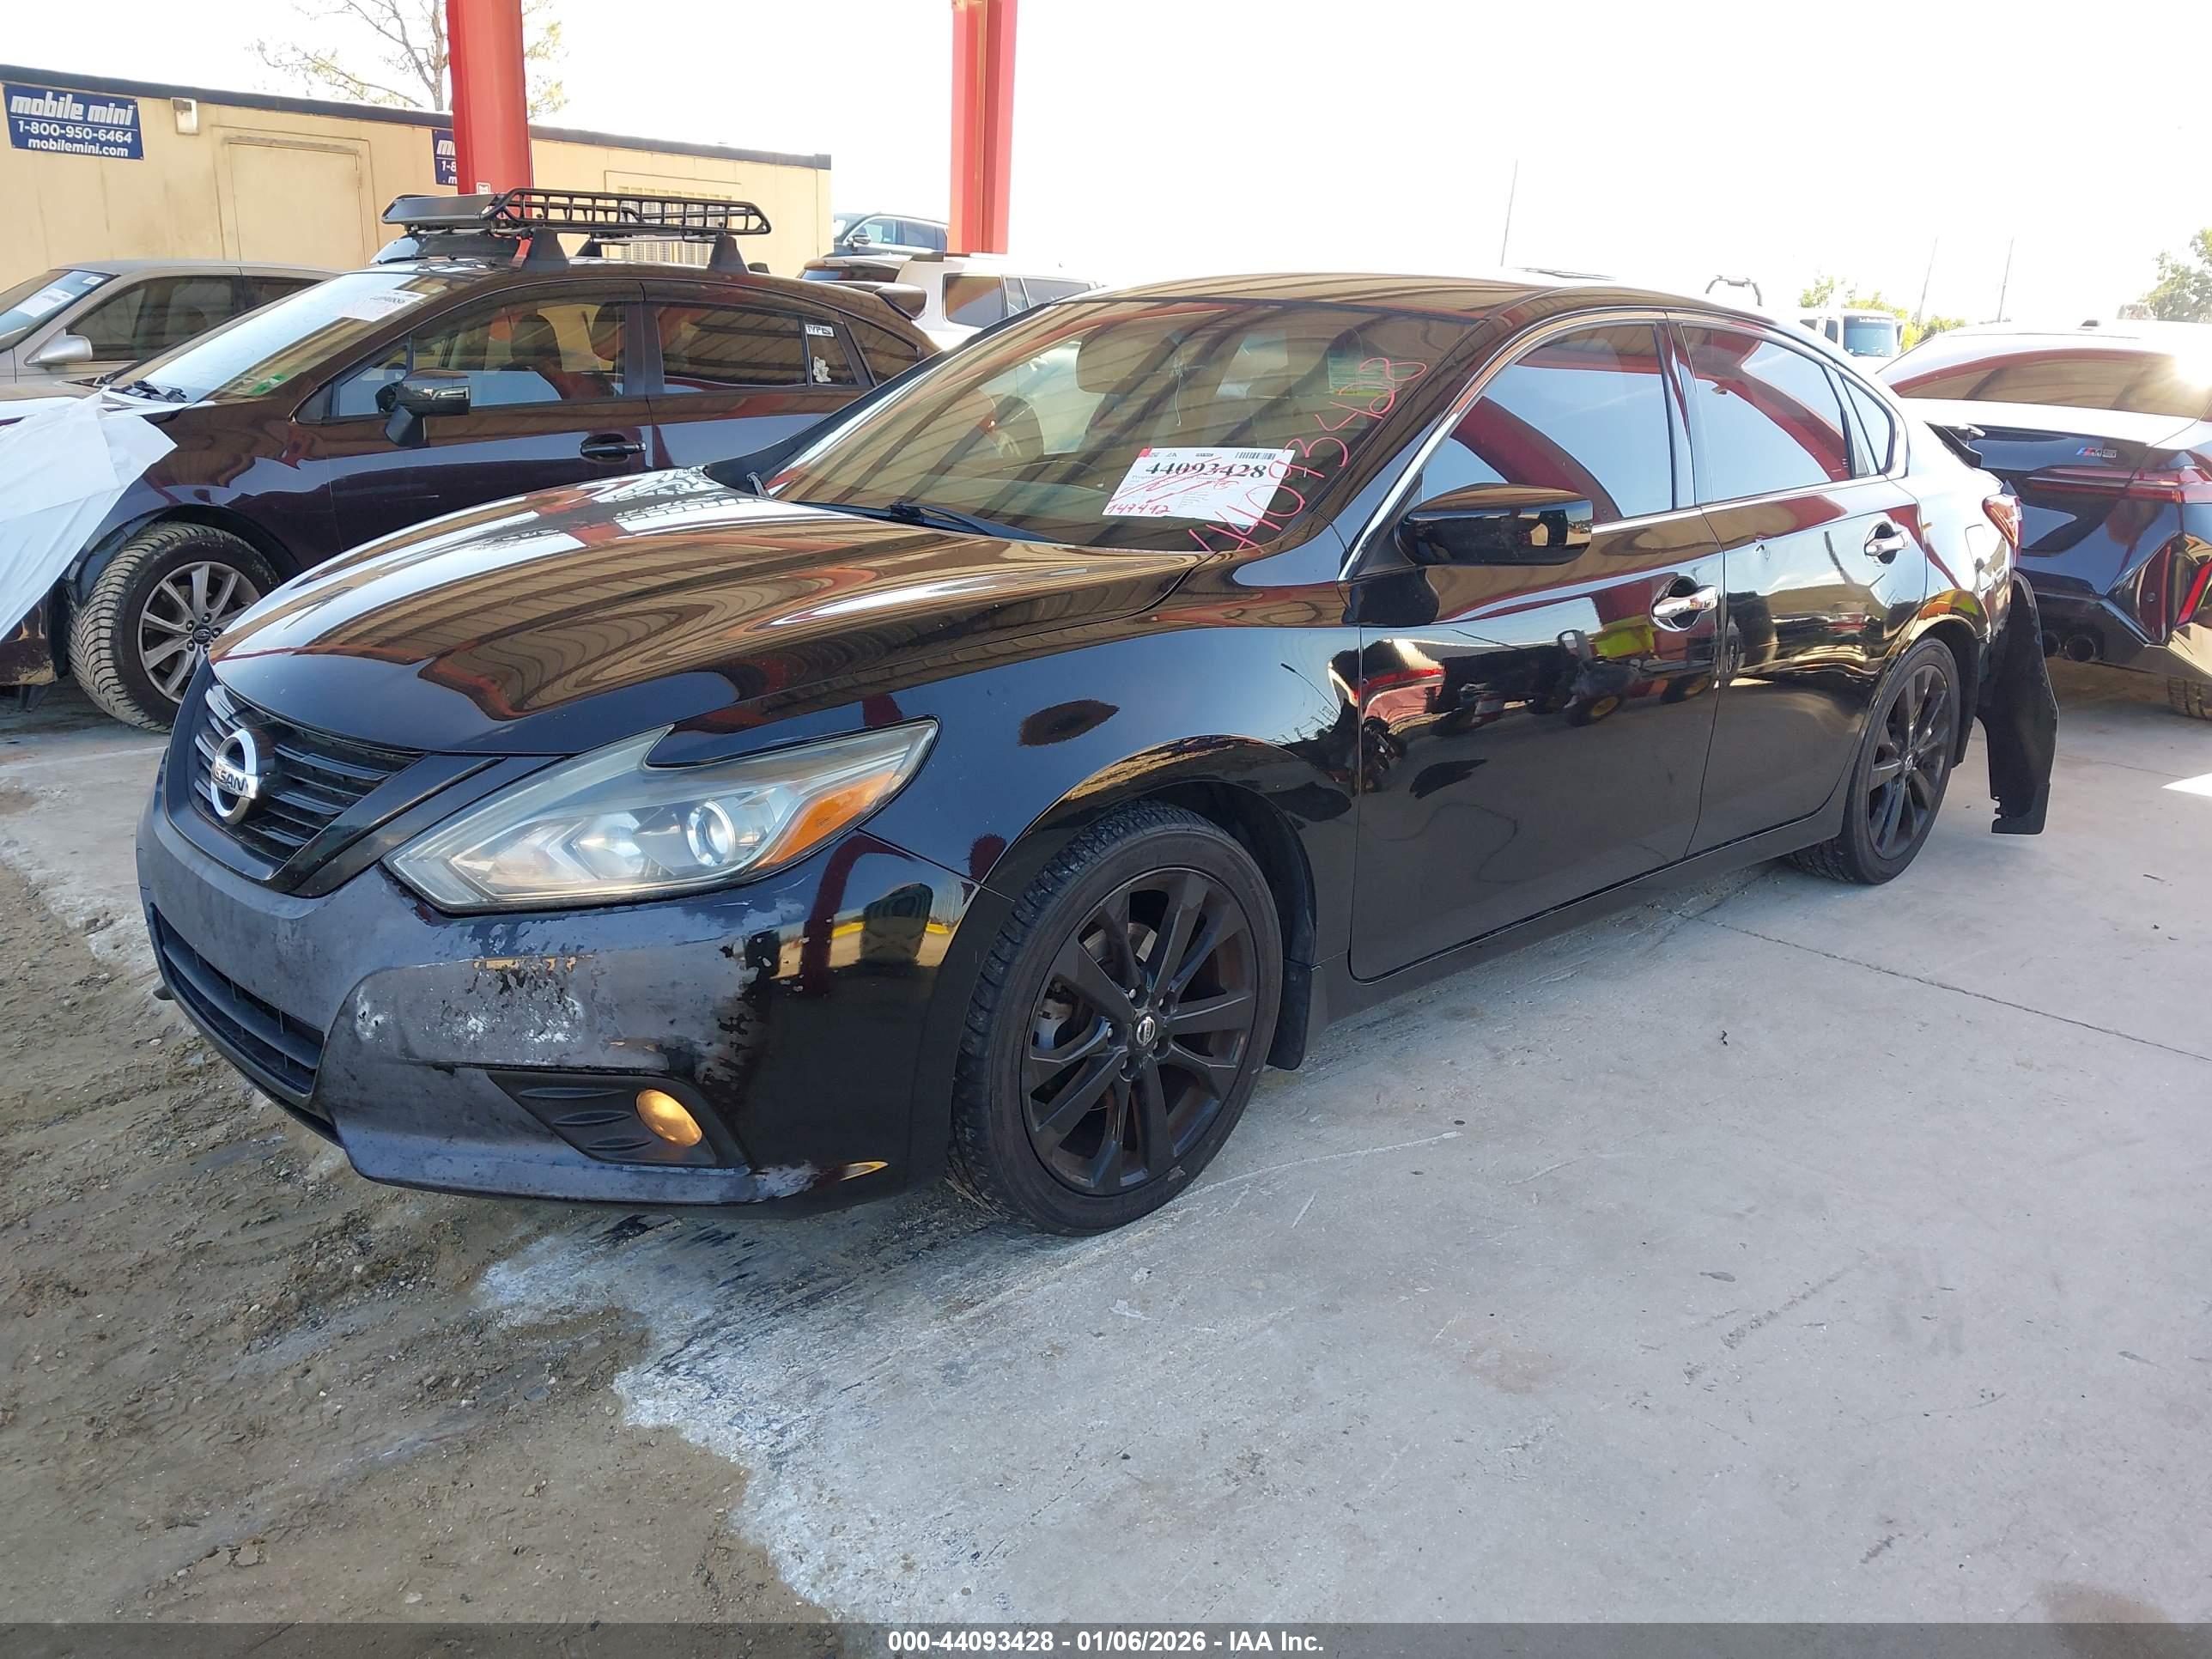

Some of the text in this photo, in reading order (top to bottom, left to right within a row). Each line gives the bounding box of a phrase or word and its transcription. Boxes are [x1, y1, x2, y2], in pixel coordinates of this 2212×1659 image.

[10, 91, 135, 126] mobile mini
[18, 120, 133, 143] 1-800-950-6464
[28, 137, 129, 157] mobilemini.com
[1146, 462, 1267, 478] 44093428
[213, 763, 249, 793] SSAN
